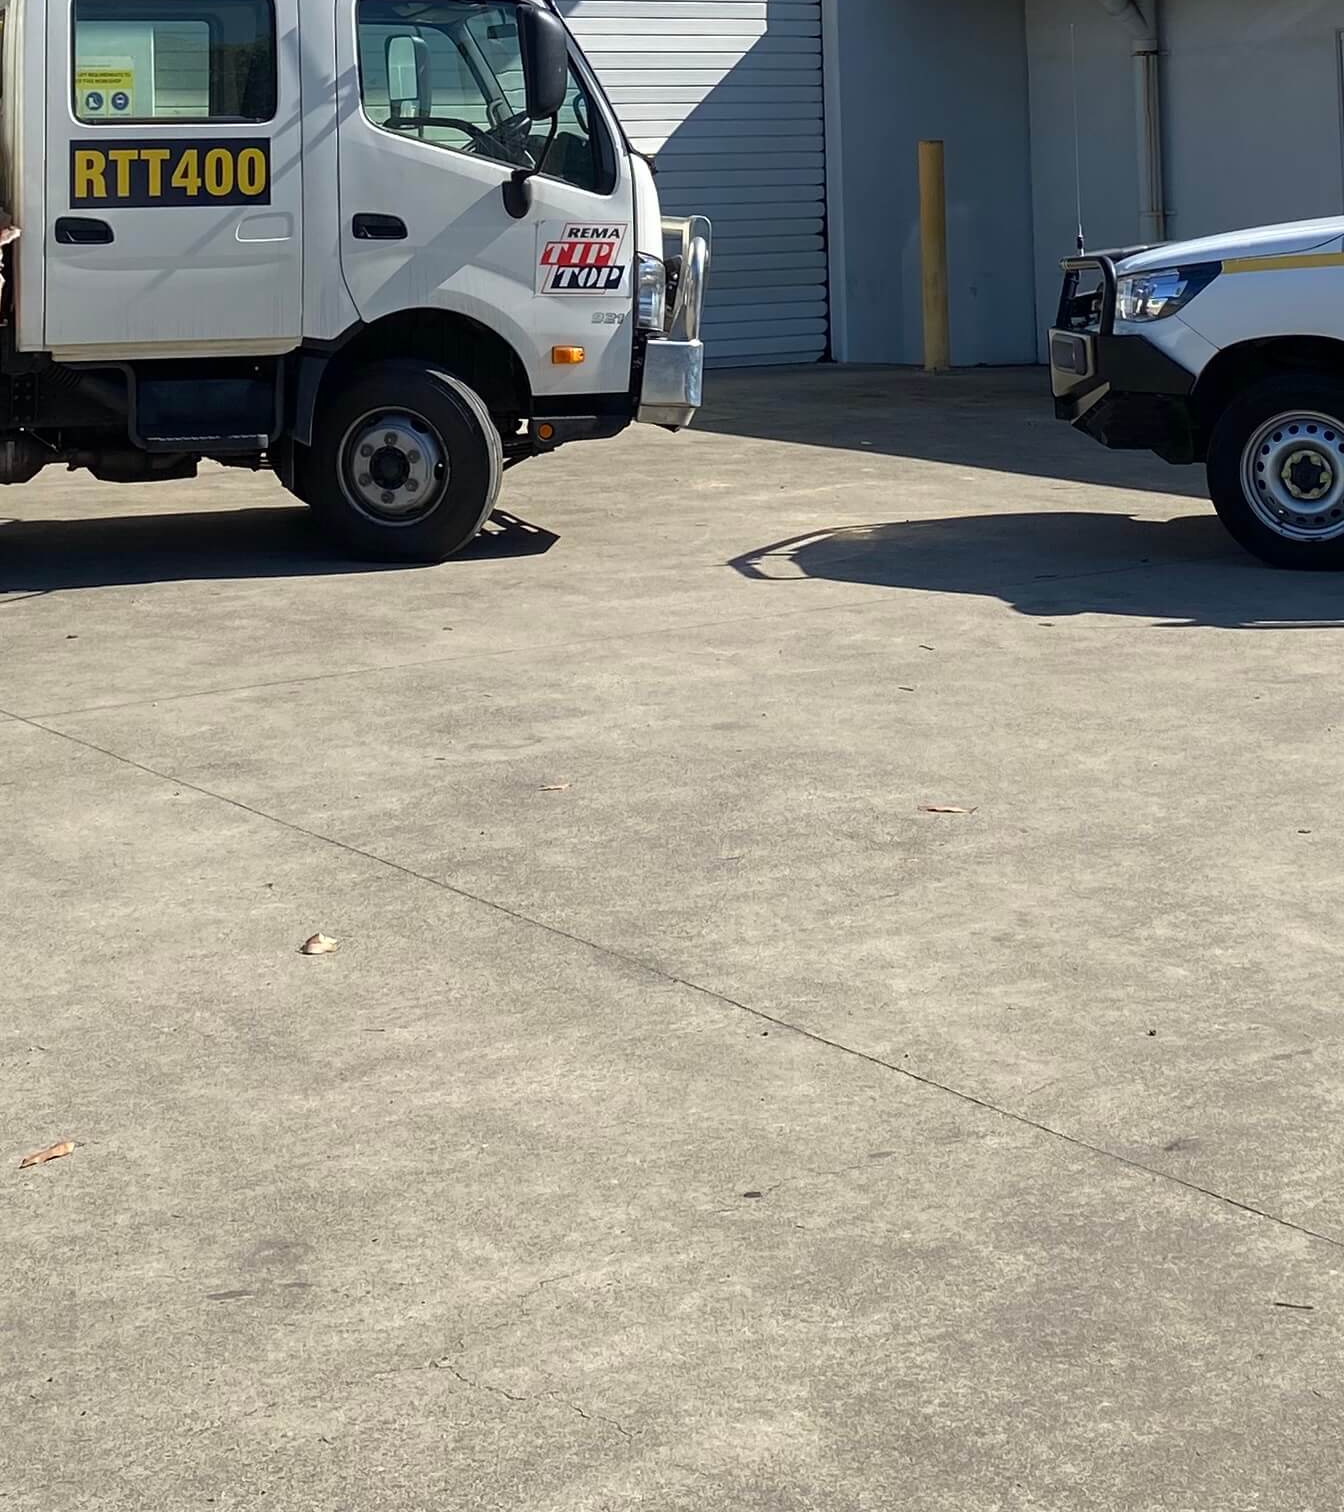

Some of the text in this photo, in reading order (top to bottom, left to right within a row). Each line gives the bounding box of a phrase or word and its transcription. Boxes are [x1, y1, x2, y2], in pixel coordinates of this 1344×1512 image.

[73, 147, 267, 198] RTT400
[567, 227, 621, 239] REMA
[545, 243, 610, 264] TIP
[556, 267, 620, 288] TOP
